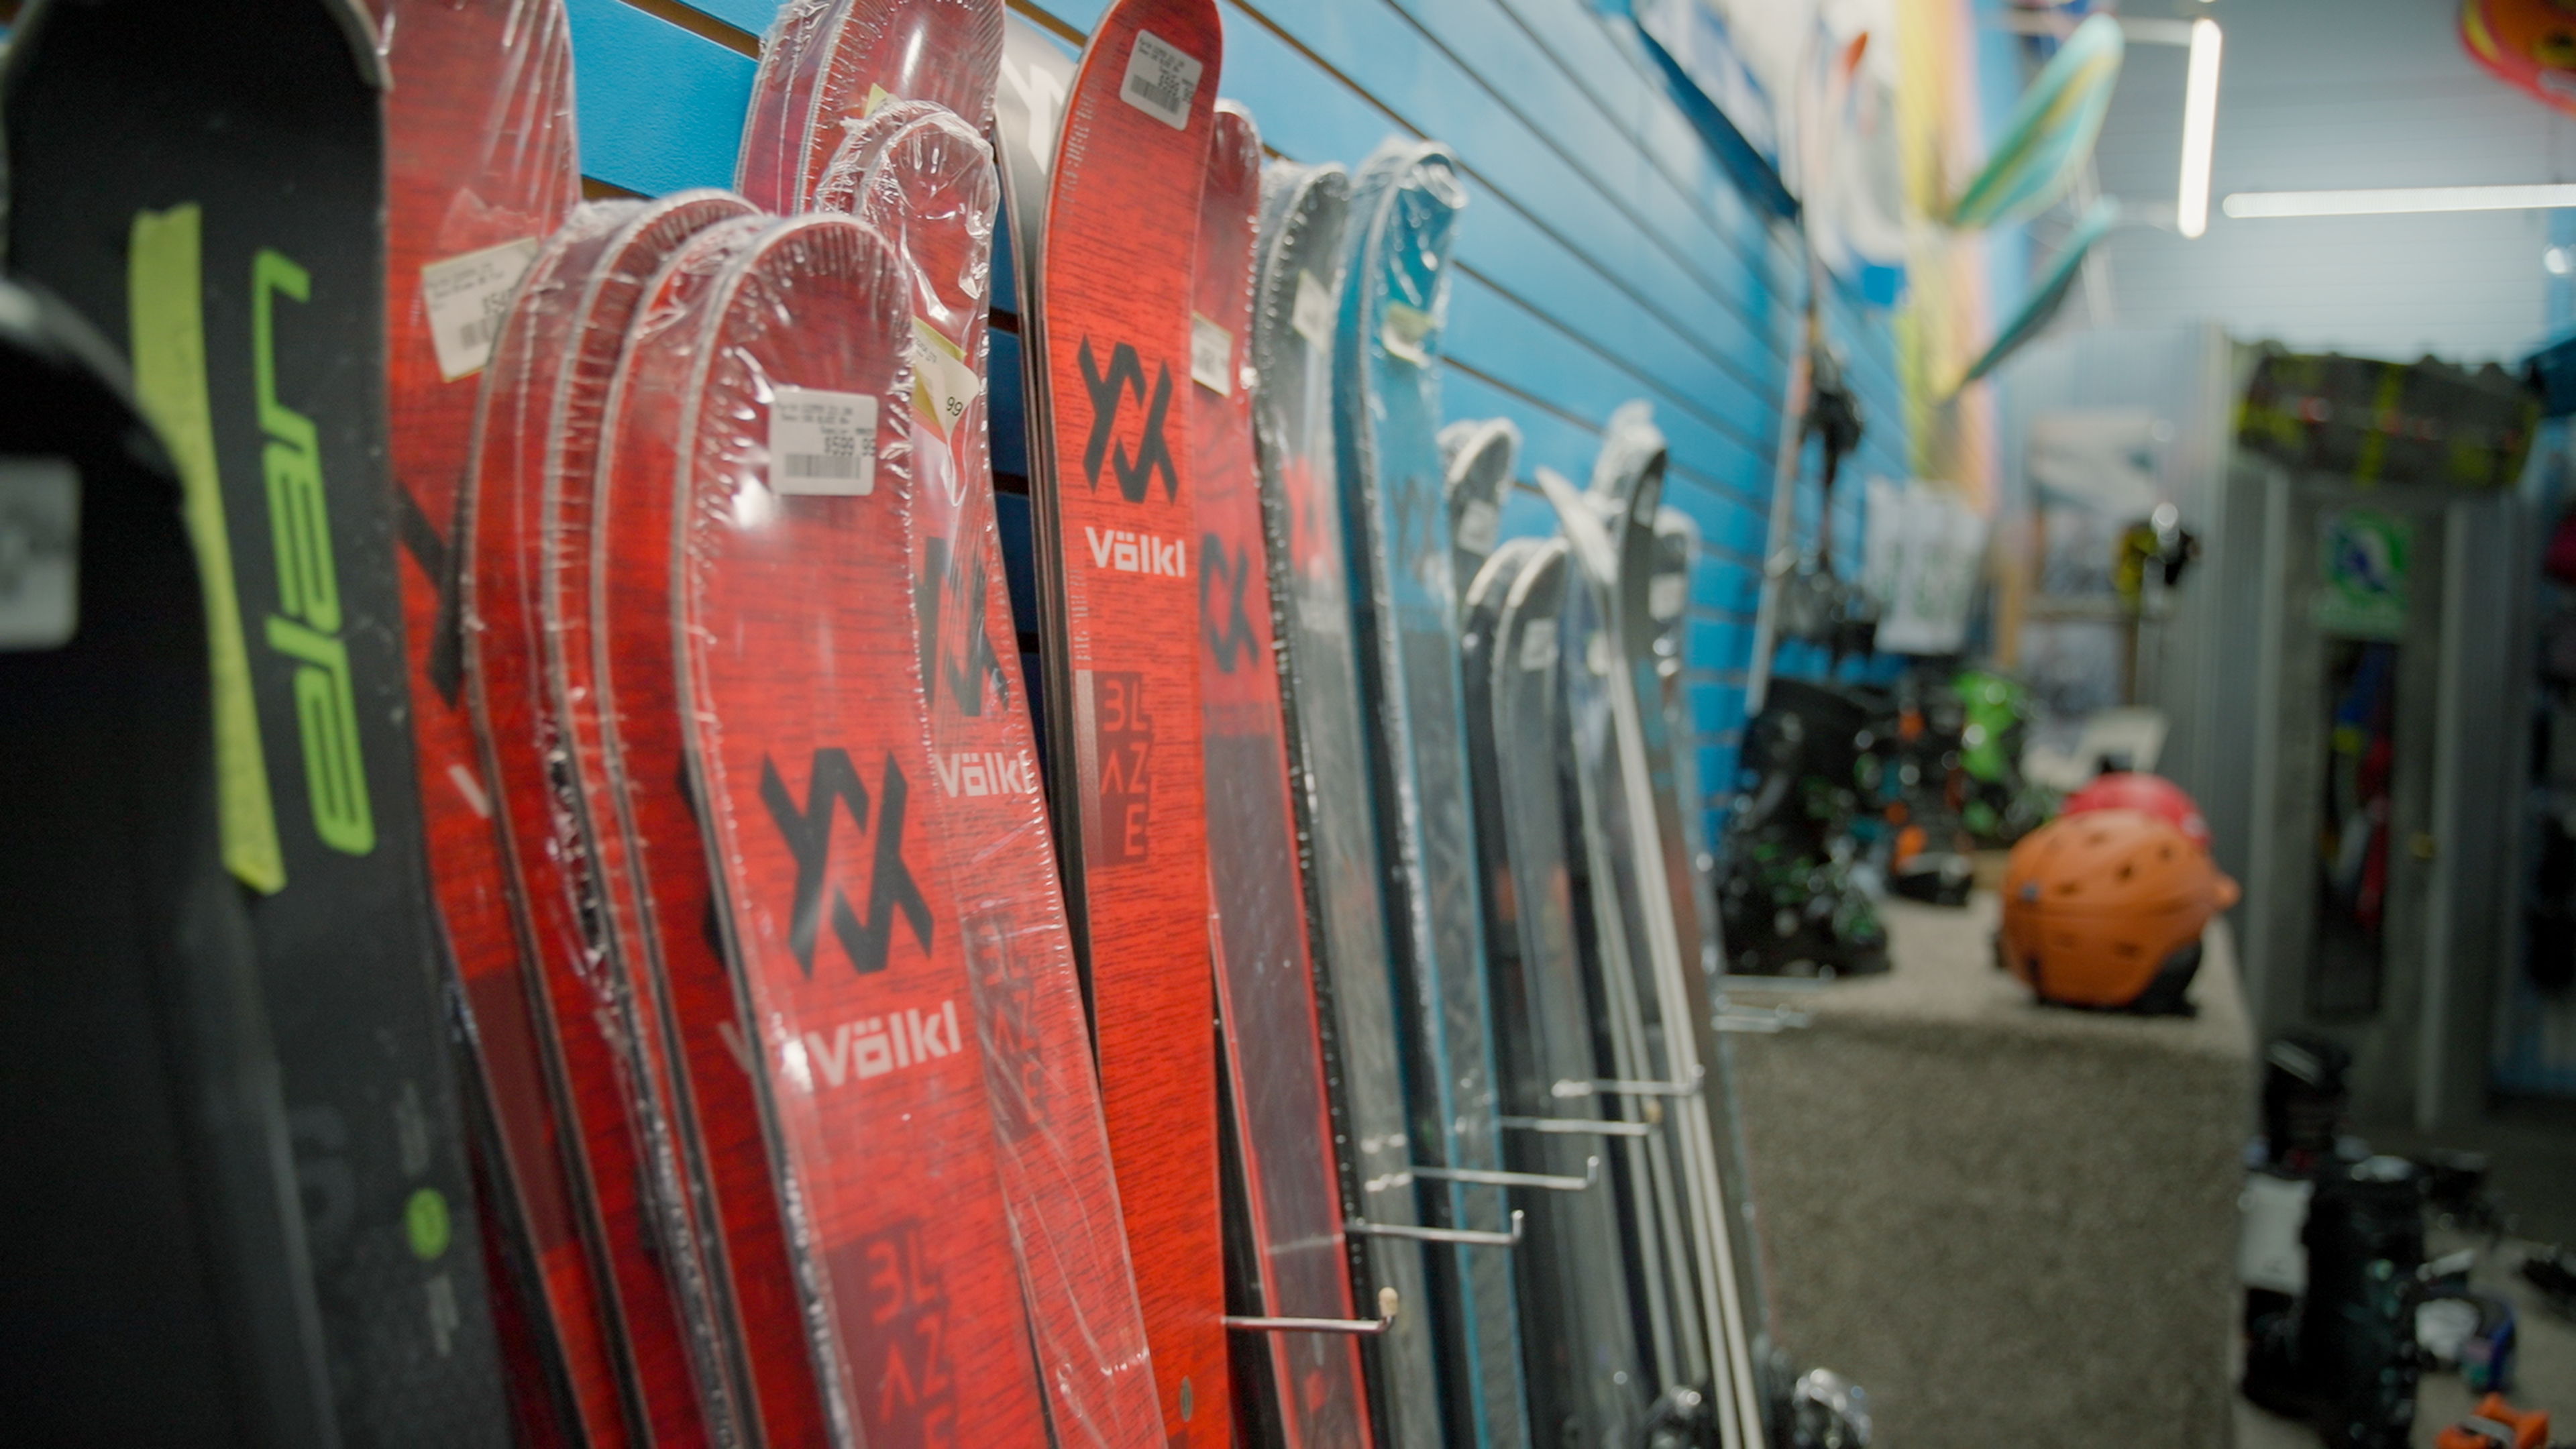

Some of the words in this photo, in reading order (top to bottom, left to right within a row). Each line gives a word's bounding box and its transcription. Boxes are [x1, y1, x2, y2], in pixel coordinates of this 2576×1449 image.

[947, 396, 963, 417] 99
[1085, 526, 1186, 578] Völkl
[932, 751, 1032, 798] Völkl
[804, 1000, 962, 1088] Völkl
